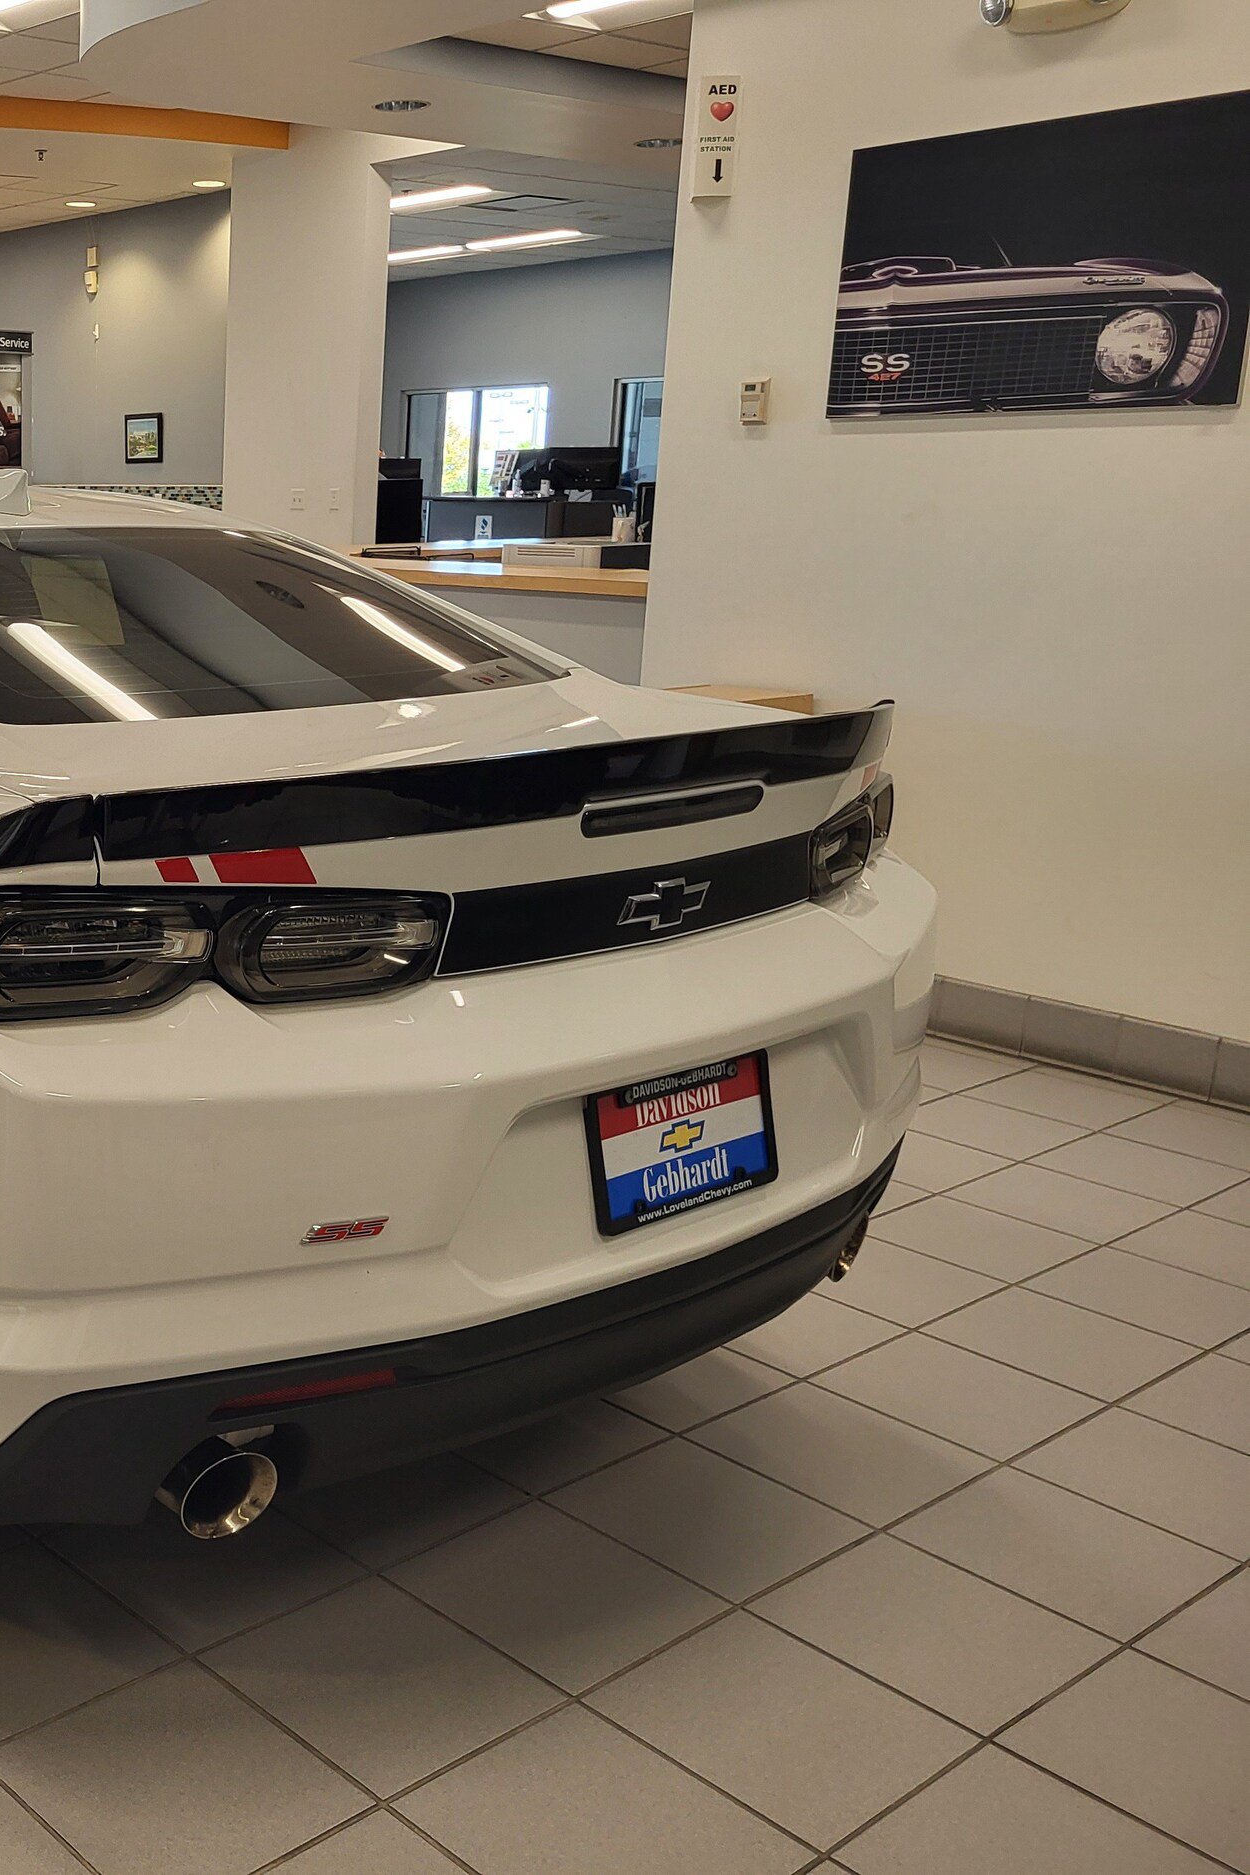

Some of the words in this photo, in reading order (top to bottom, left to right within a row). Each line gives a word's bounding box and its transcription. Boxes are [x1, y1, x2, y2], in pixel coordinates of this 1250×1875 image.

[708, 84, 737, 96] AED
[0, 337, 30, 349] Service
[860, 353, 910, 373] SS
[634, 1083, 722, 1128] Davidson
[643, 1147, 730, 1203] Gebhardt
[637, 1178, 753, 1223] www.LovelandChevy.com
[300, 1216, 390, 1245] SS
